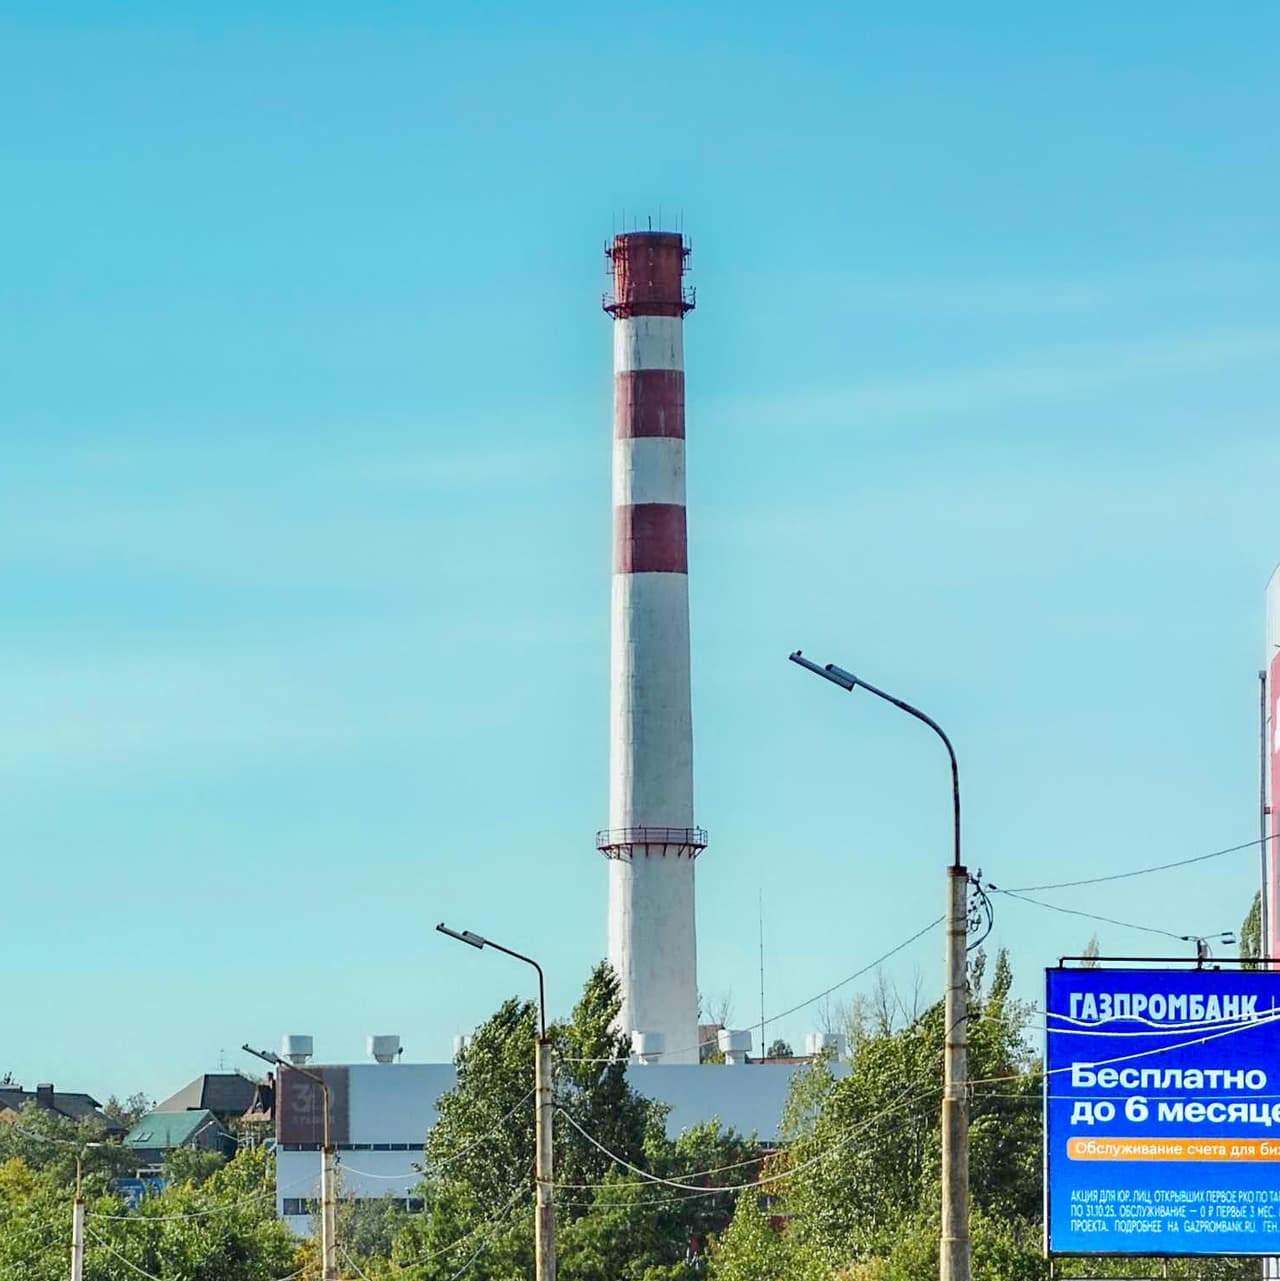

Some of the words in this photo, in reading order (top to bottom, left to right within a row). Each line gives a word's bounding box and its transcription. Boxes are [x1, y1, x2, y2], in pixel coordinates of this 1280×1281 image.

[1070, 993, 1259, 1022] ГАЗПРОМБАНК
[1071, 1062, 1267, 1091] Бесплатно
[1071, 1100, 1116, 1125] до
[1124, 1095, 1148, 1123] 6
[1075, 1141, 1183, 1156] Обслуживание
[1187, 1145, 1226, 1156] счета
[1230, 1145, 1256, 1158] для
[1071, 1190, 1098, 1203] АКЦИЯ
[1099, 1190, 1116, 1203] ДЛЯ
[1117, 1190, 1132, 1203] ЮР.
[1153, 1190, 1204, 1203] ОТКРЫВШИХ
[1206, 1190, 1237, 1203] ПЕРВОЕ
[1238, 1190, 1255, 1203] РКО
[1255, 1190, 1268, 1203] ПО
[1071, 1204, 1083, 1217] ПО
[1119, 1204, 1187, 1217] ОБСЛУЖИВАНИЕ
[1216, 1204, 1247, 1217] ПЕРВЫЕ
[1115, 1219, 1162, 1234] ПОДРОБНЕЕ
[1167, 1220, 1179, 1233] НА
